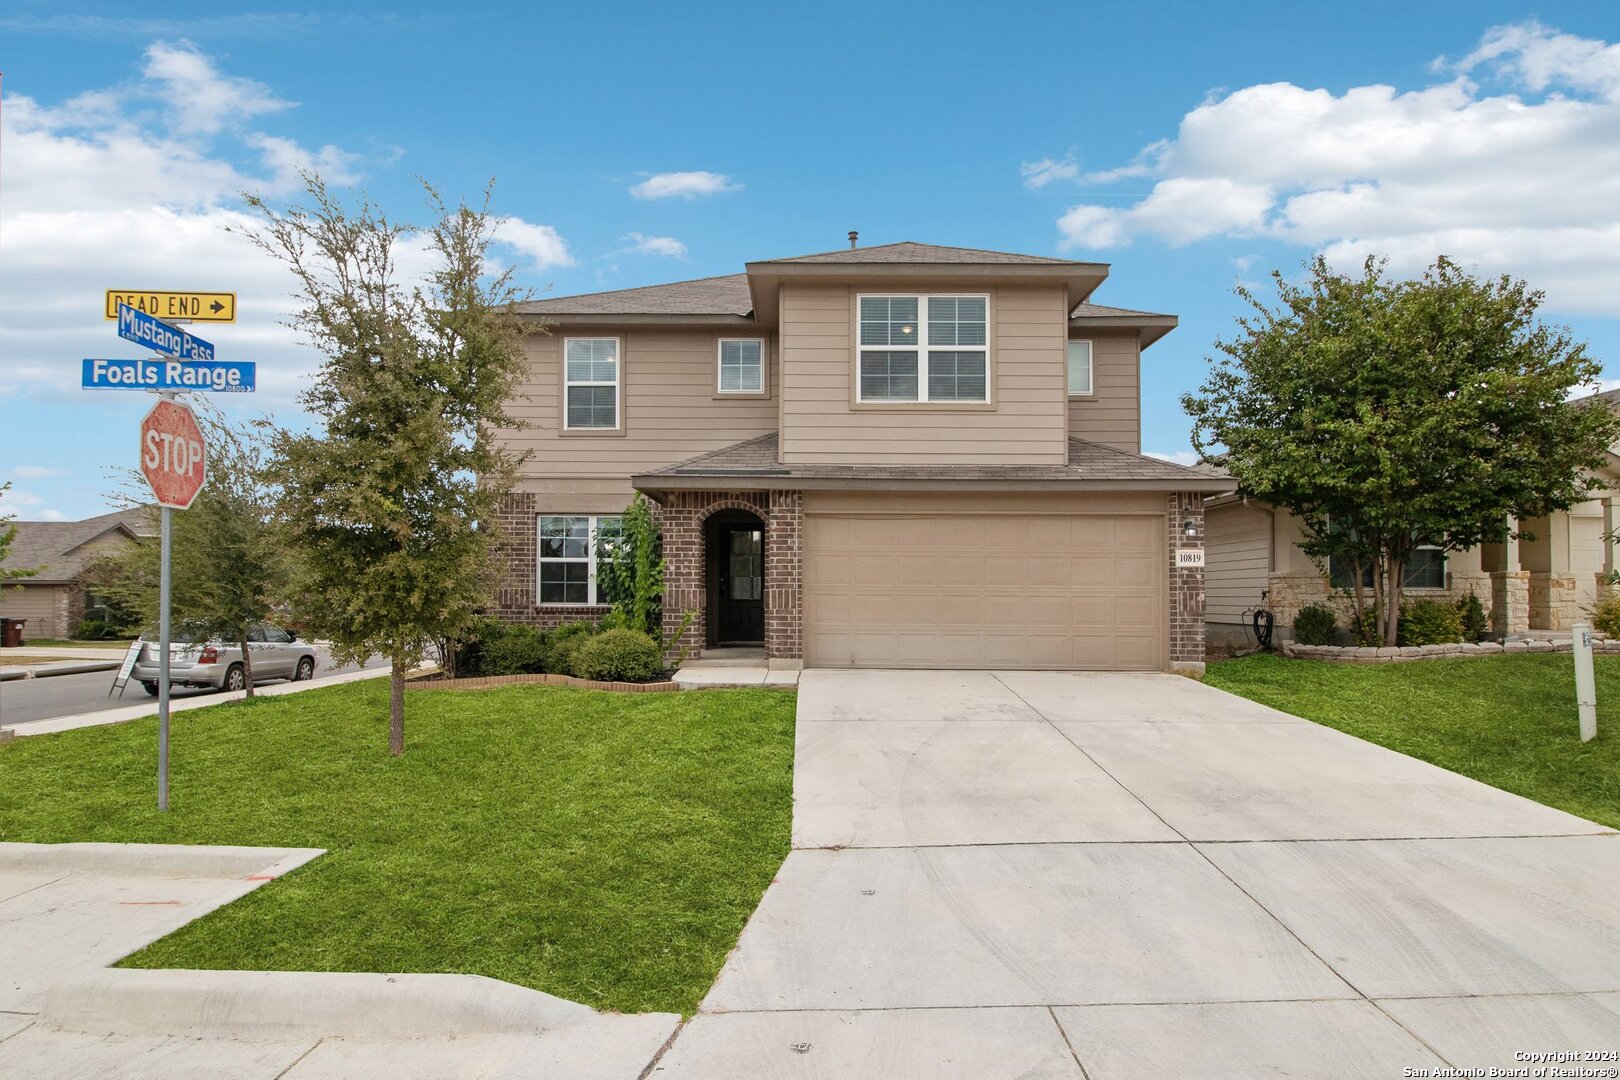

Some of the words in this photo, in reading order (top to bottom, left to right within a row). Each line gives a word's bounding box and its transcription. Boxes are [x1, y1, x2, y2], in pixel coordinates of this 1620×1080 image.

[114, 295, 159, 315] DEAD
[168, 296, 200, 316] END
[120, 305, 181, 356] Mustang
[183, 333, 213, 361] Pass
[93, 360, 158, 384] Foals
[165, 362, 241, 390] Range
[145, 429, 201, 477] STOP
[1180, 554, 1201, 563] 10819
